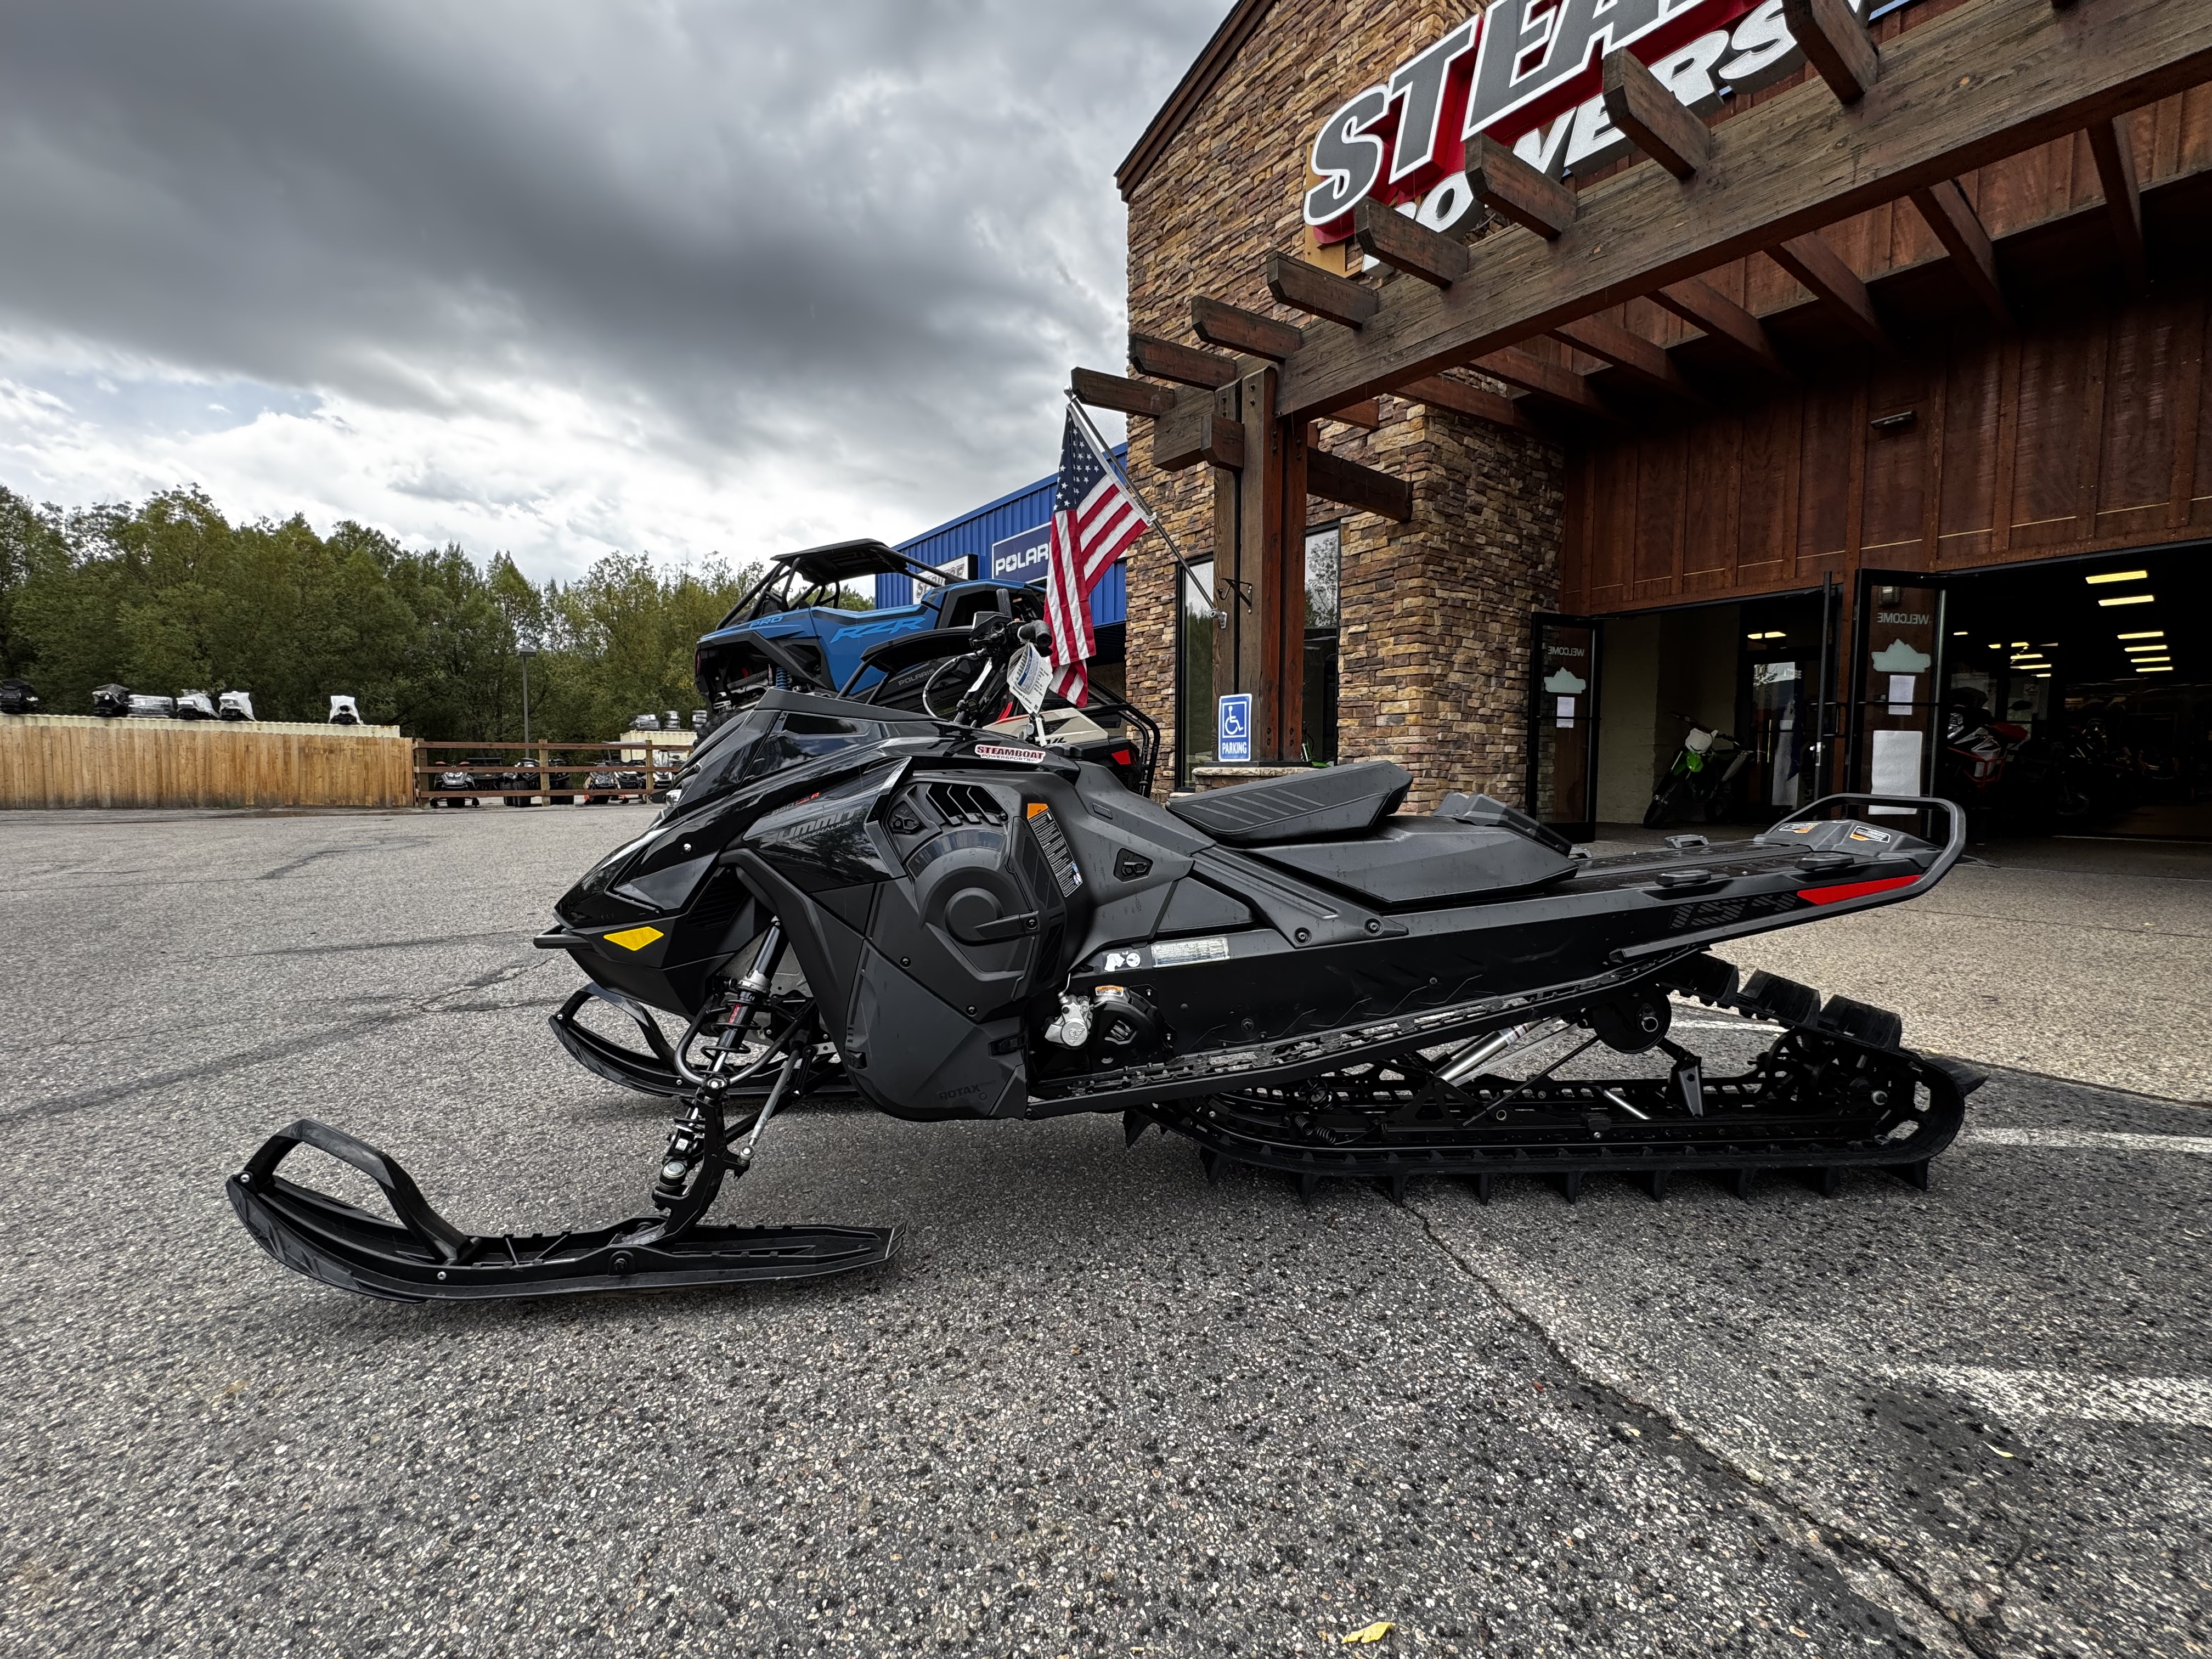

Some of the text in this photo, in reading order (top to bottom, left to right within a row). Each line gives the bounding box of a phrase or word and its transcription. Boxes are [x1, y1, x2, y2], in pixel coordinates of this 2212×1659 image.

[1304, 0, 1702, 226] STEA
[995, 542, 1052, 576] POLAR
[749, 616, 783, 629] PRO
[830, 617, 926, 644] RZR
[898, 669, 935, 686] POLARIS
[977, 746, 1045, 760] STEAMBOAT
[1222, 742, 1246, 754] PARKING
[760, 805, 862, 849] SUMMIT
[794, 820, 851, 842] ADRENALINE
[939, 1084, 980, 1100] ROTAX
